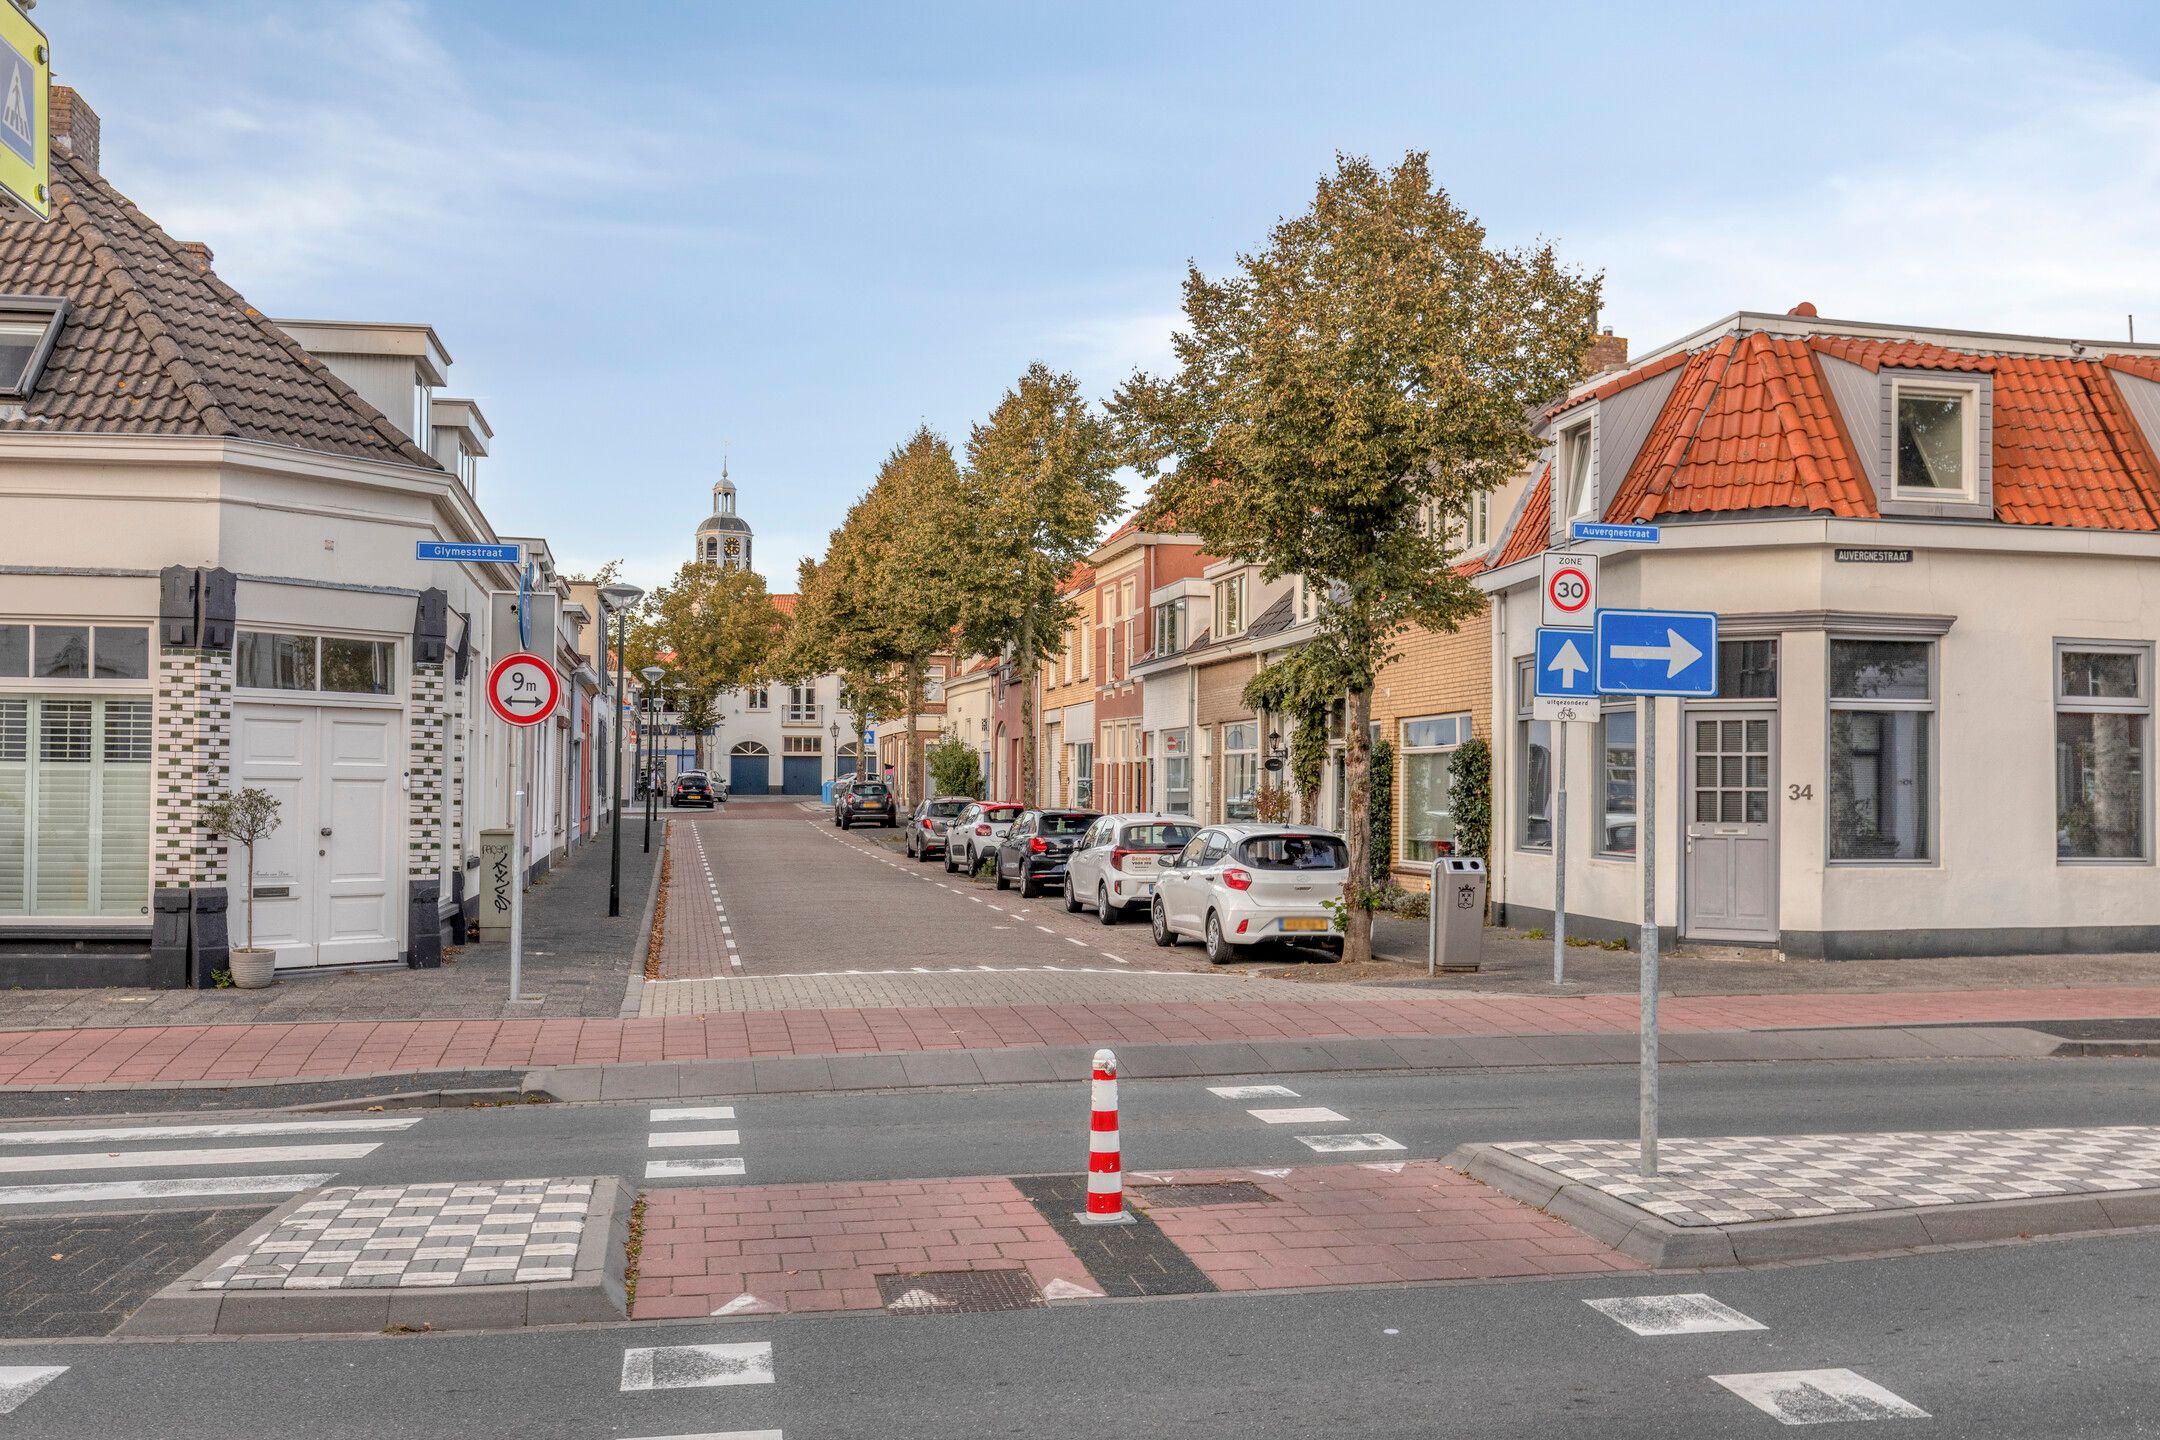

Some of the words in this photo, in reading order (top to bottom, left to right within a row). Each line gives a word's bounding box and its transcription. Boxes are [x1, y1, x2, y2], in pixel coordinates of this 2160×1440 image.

[1582, 526, 1650, 539] Auvergnestraat
[433, 546, 503, 558] Glymesstraat
[1838, 550, 1908, 562] AUVERGNESTRAAT
[1559, 557, 1583, 566] ZONE
[1557, 582, 1584, 599] 30
[1788, 784, 1814, 801] 34
